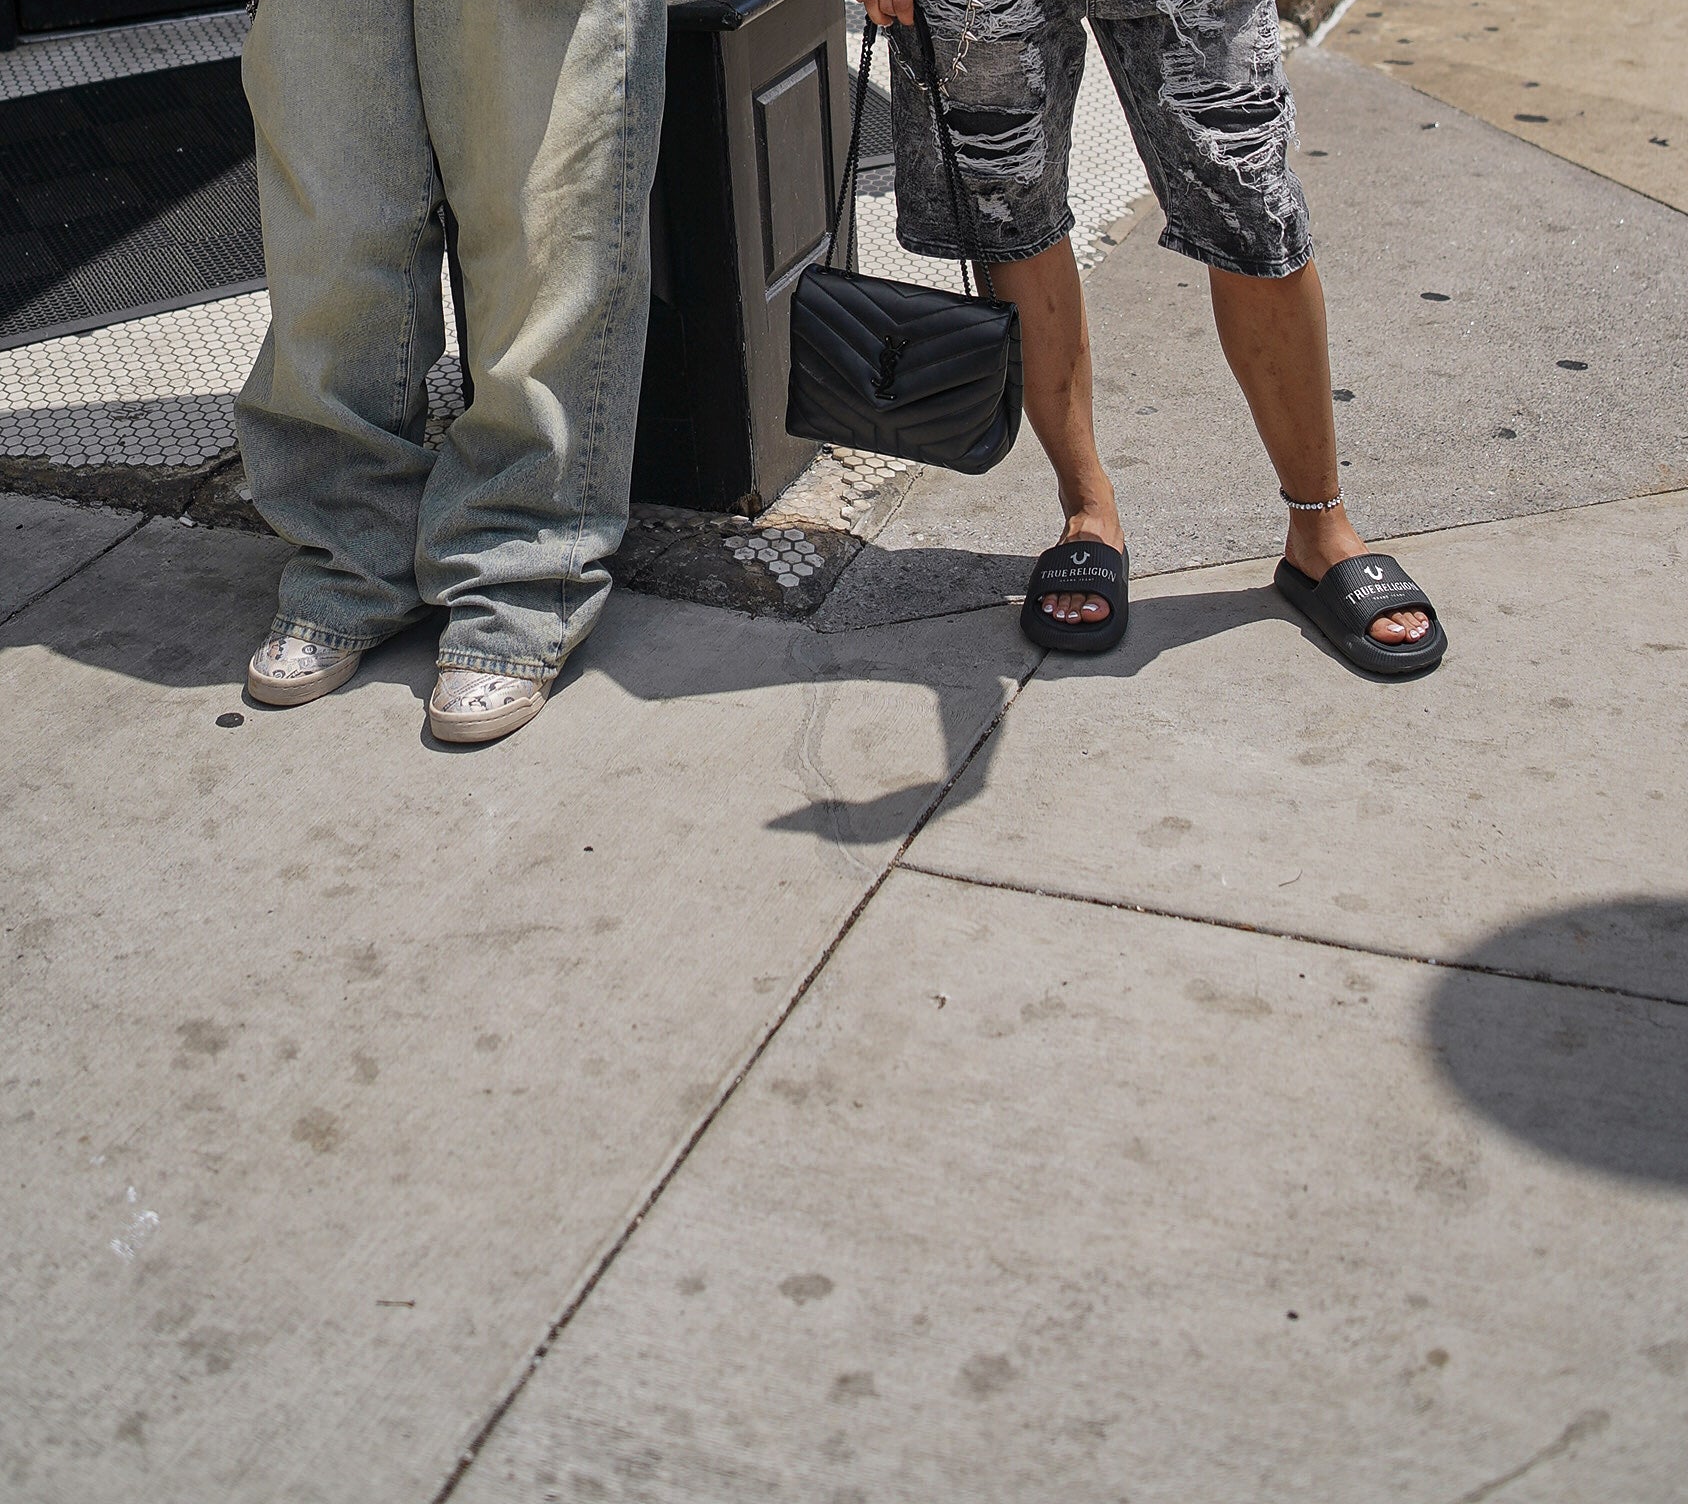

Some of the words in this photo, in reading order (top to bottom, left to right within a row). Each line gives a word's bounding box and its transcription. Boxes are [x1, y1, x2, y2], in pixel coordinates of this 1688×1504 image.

[1069, 567, 1117, 583] RELIGION
[1345, 583, 1377, 605] TRUE
[1374, 580, 1420, 594] RELIGION
